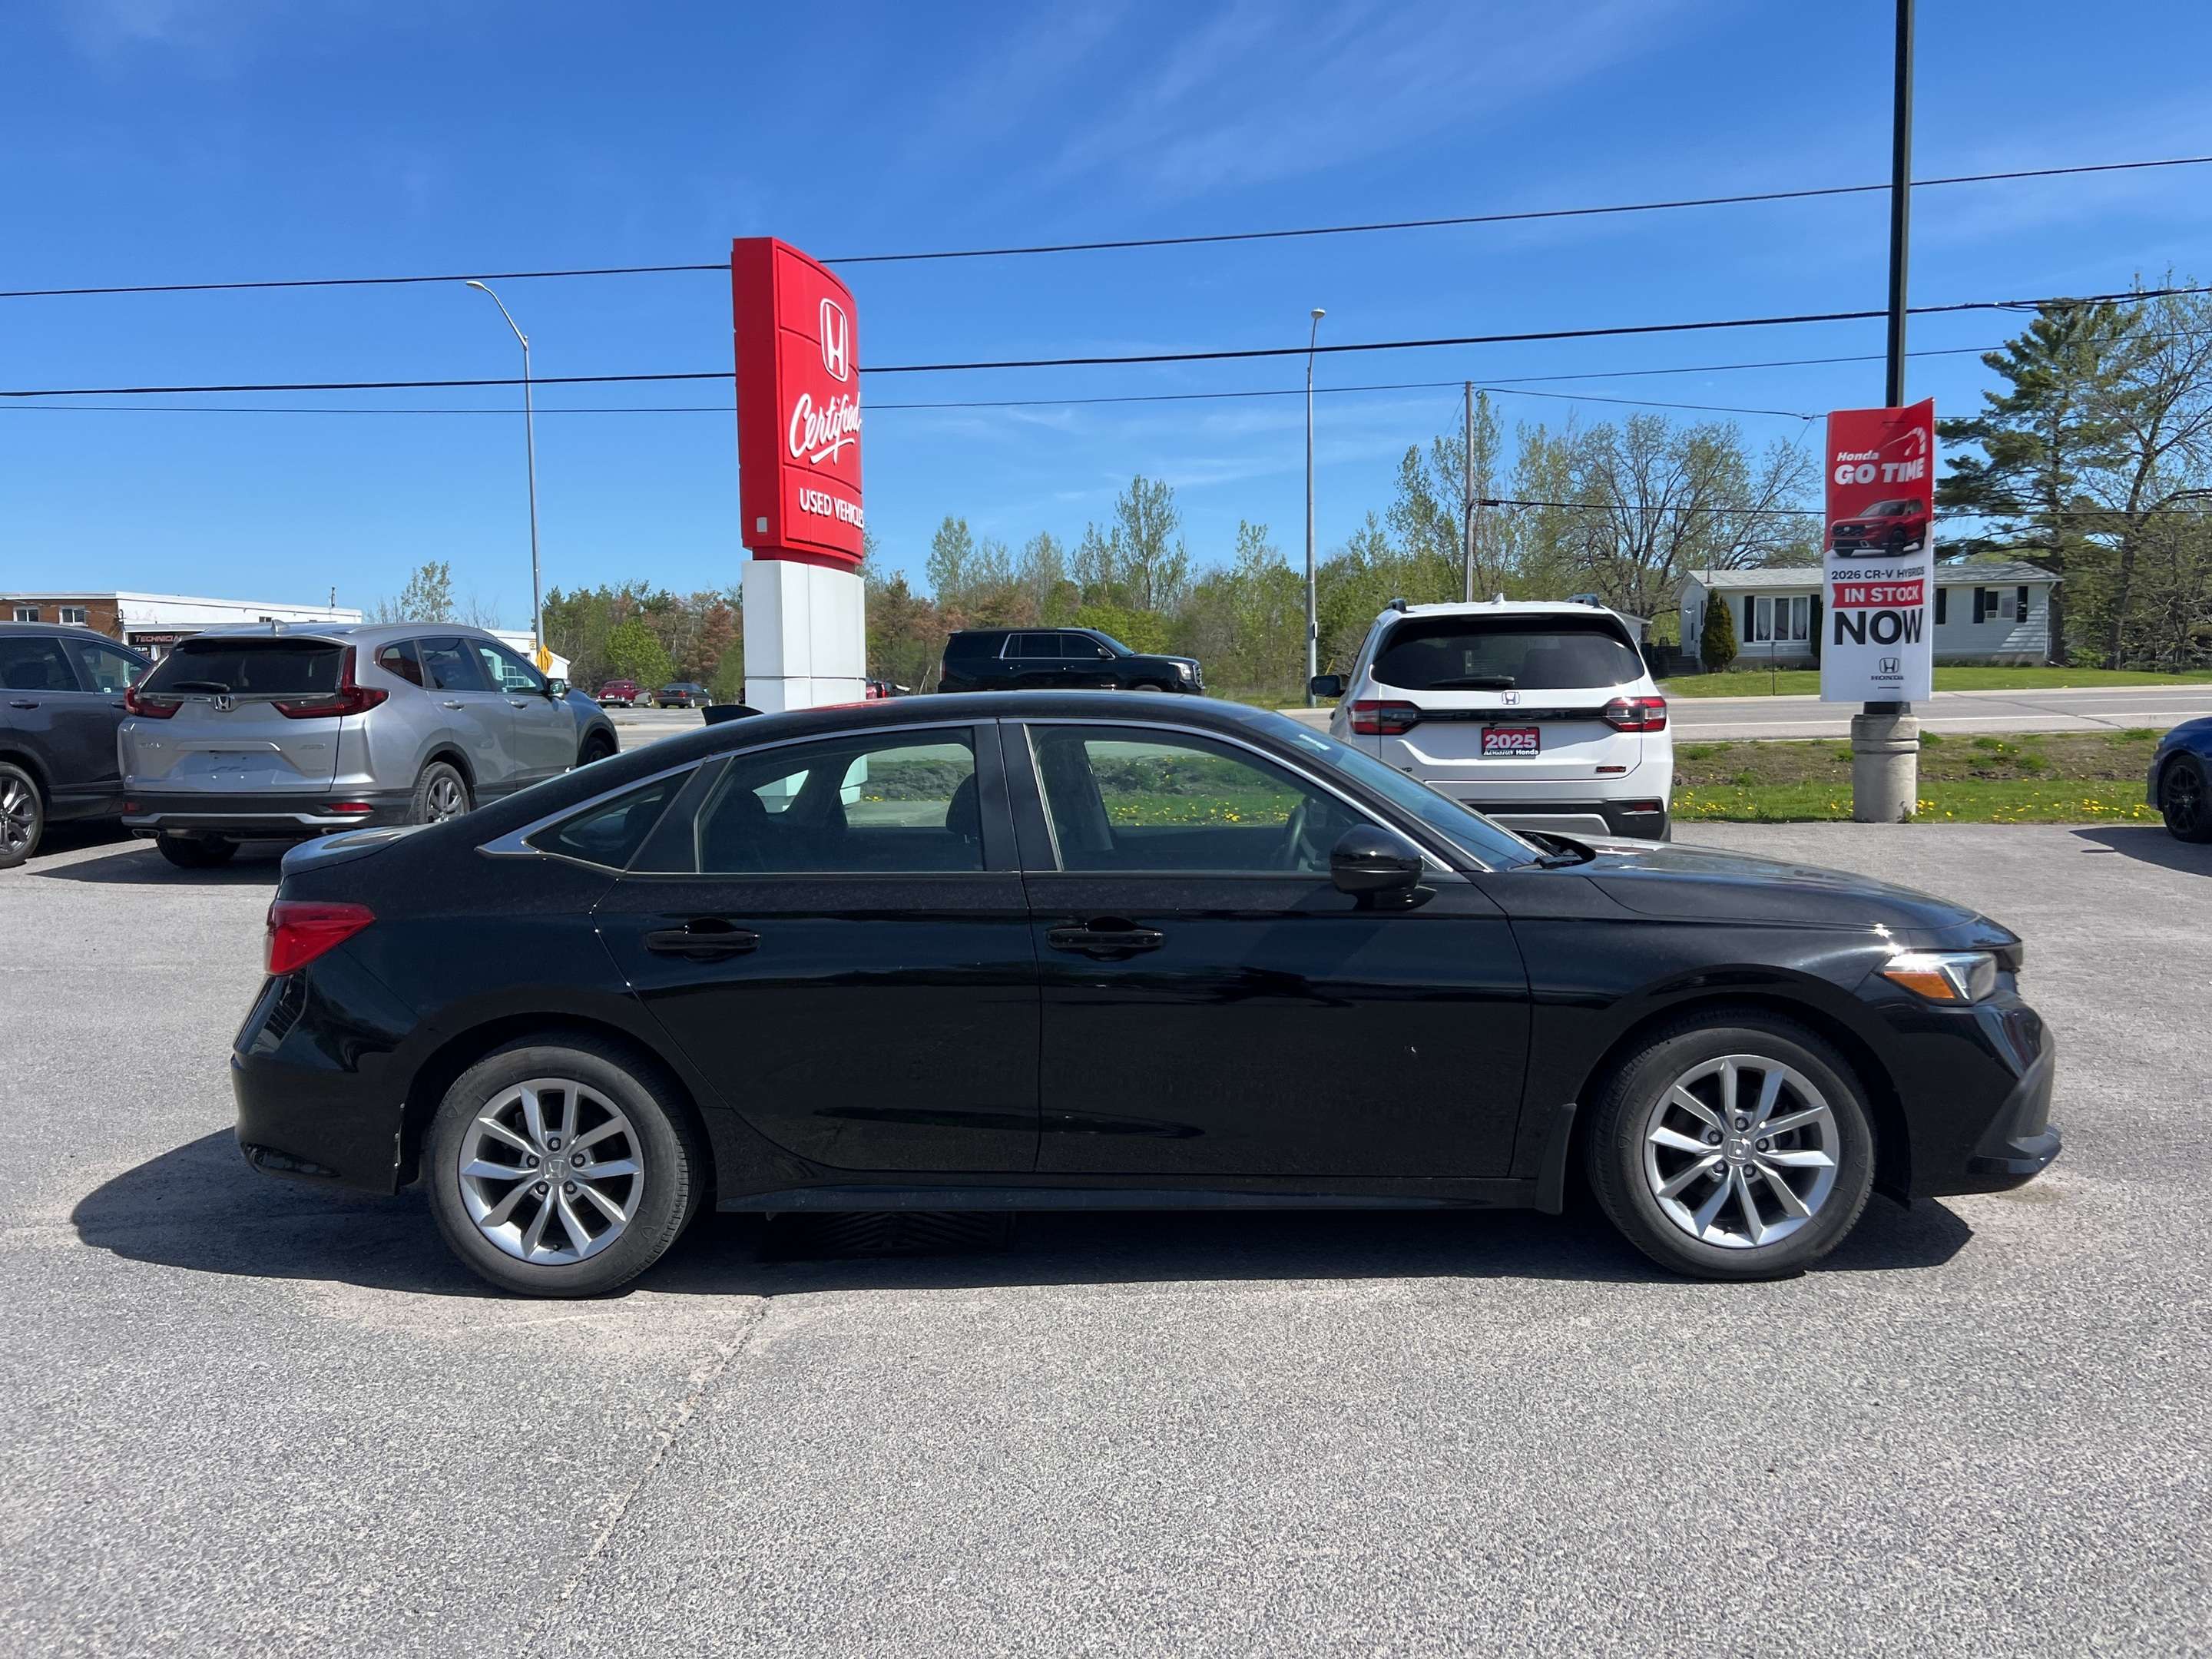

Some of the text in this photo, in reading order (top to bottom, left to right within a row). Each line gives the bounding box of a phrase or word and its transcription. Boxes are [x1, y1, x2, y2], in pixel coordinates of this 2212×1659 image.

[789, 392, 862, 465] Certified
[1836, 450, 1880, 462] Honda
[1834, 457, 1926, 485] GO TIME
[800, 487, 865, 530] USED VEHICLES
[1831, 570, 1861, 580] 2026
[1864, 570, 1893, 579] CR-V
[1844, 584, 1919, 603] IN STOCK
[1833, 609, 1924, 646] NOW
[1485, 733, 1536, 749] 2025
